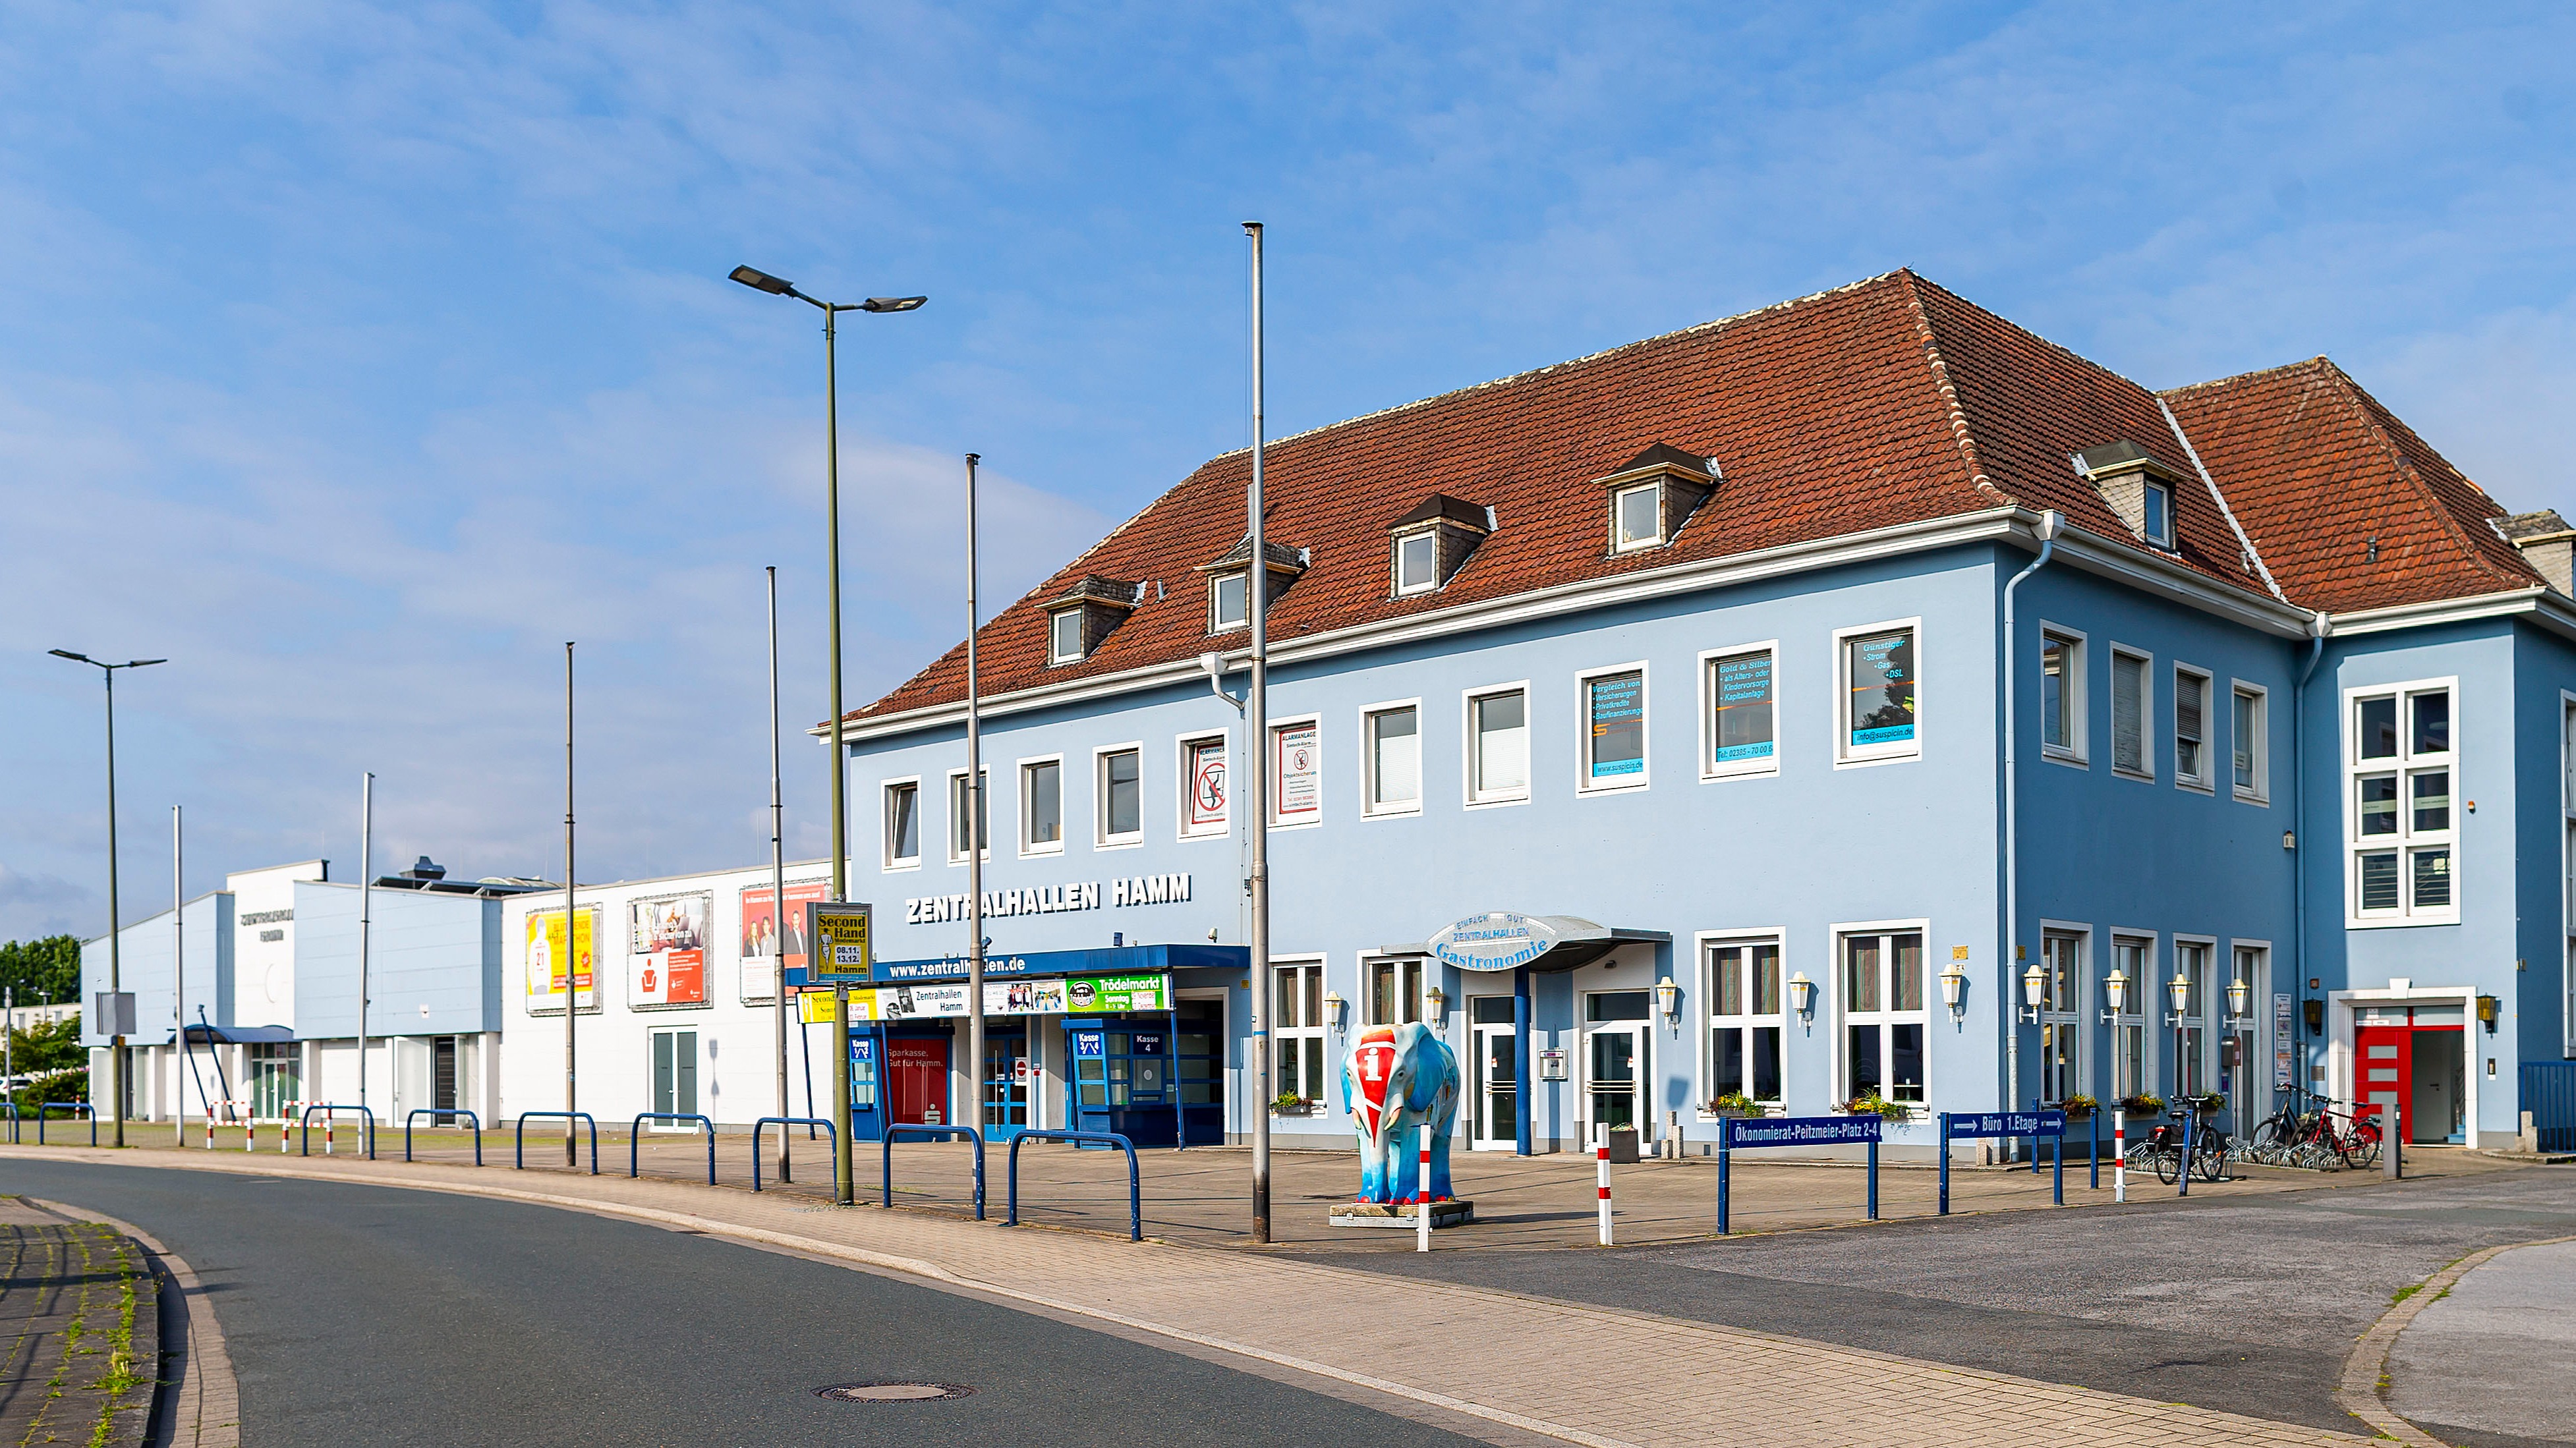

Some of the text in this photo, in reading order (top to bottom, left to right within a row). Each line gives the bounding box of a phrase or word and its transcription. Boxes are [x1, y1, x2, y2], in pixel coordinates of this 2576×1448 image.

[1864, 640, 1905, 652] Günstiger
[1867, 652, 1885, 661] Strom
[1720, 665, 1737, 673] Gold
[1749, 660, 1771, 669] Silber
[1755, 669, 1769, 678] oder
[1889, 669, 1903, 678] DSL
[1593, 682, 1625, 693] Vergleich
[1724, 679, 1769, 691] Kindervorsorge
[1595, 690, 1637, 702] Versicherungen
[1725, 689, 1765, 702] Kapitalanlage
[1595, 700, 1630, 711] Privatkredite
[1282, 731, 1317, 741] ALARMANLAGE
[1856, 727, 1913, 740] info@suspicin.de
[1112, 872, 1191, 907] HAMM
[818, 916, 865, 927] Second
[1456, 914, 1524, 930] EINFACH GUT
[834, 928, 865, 938] Hand
[1453, 927, 1528, 943] ZENTRALHALLEN
[537, 953, 544, 966] 21
[1436, 940, 1548, 969] Gastronomie
[1099, 976, 1160, 991] Trödelmarkt
[916, 989, 961, 1000] Zentralhallen
[1105, 995, 1130, 1005] Sonntag
[940, 1003, 963, 1011] Hamm
[1364, 1047, 1383, 1080] i
[1982, 1115, 2038, 1133] Büro 1.Etage
[1735, 1123, 1877, 1142] Ökonomierat-Peitzmeier-Platz 2-4
